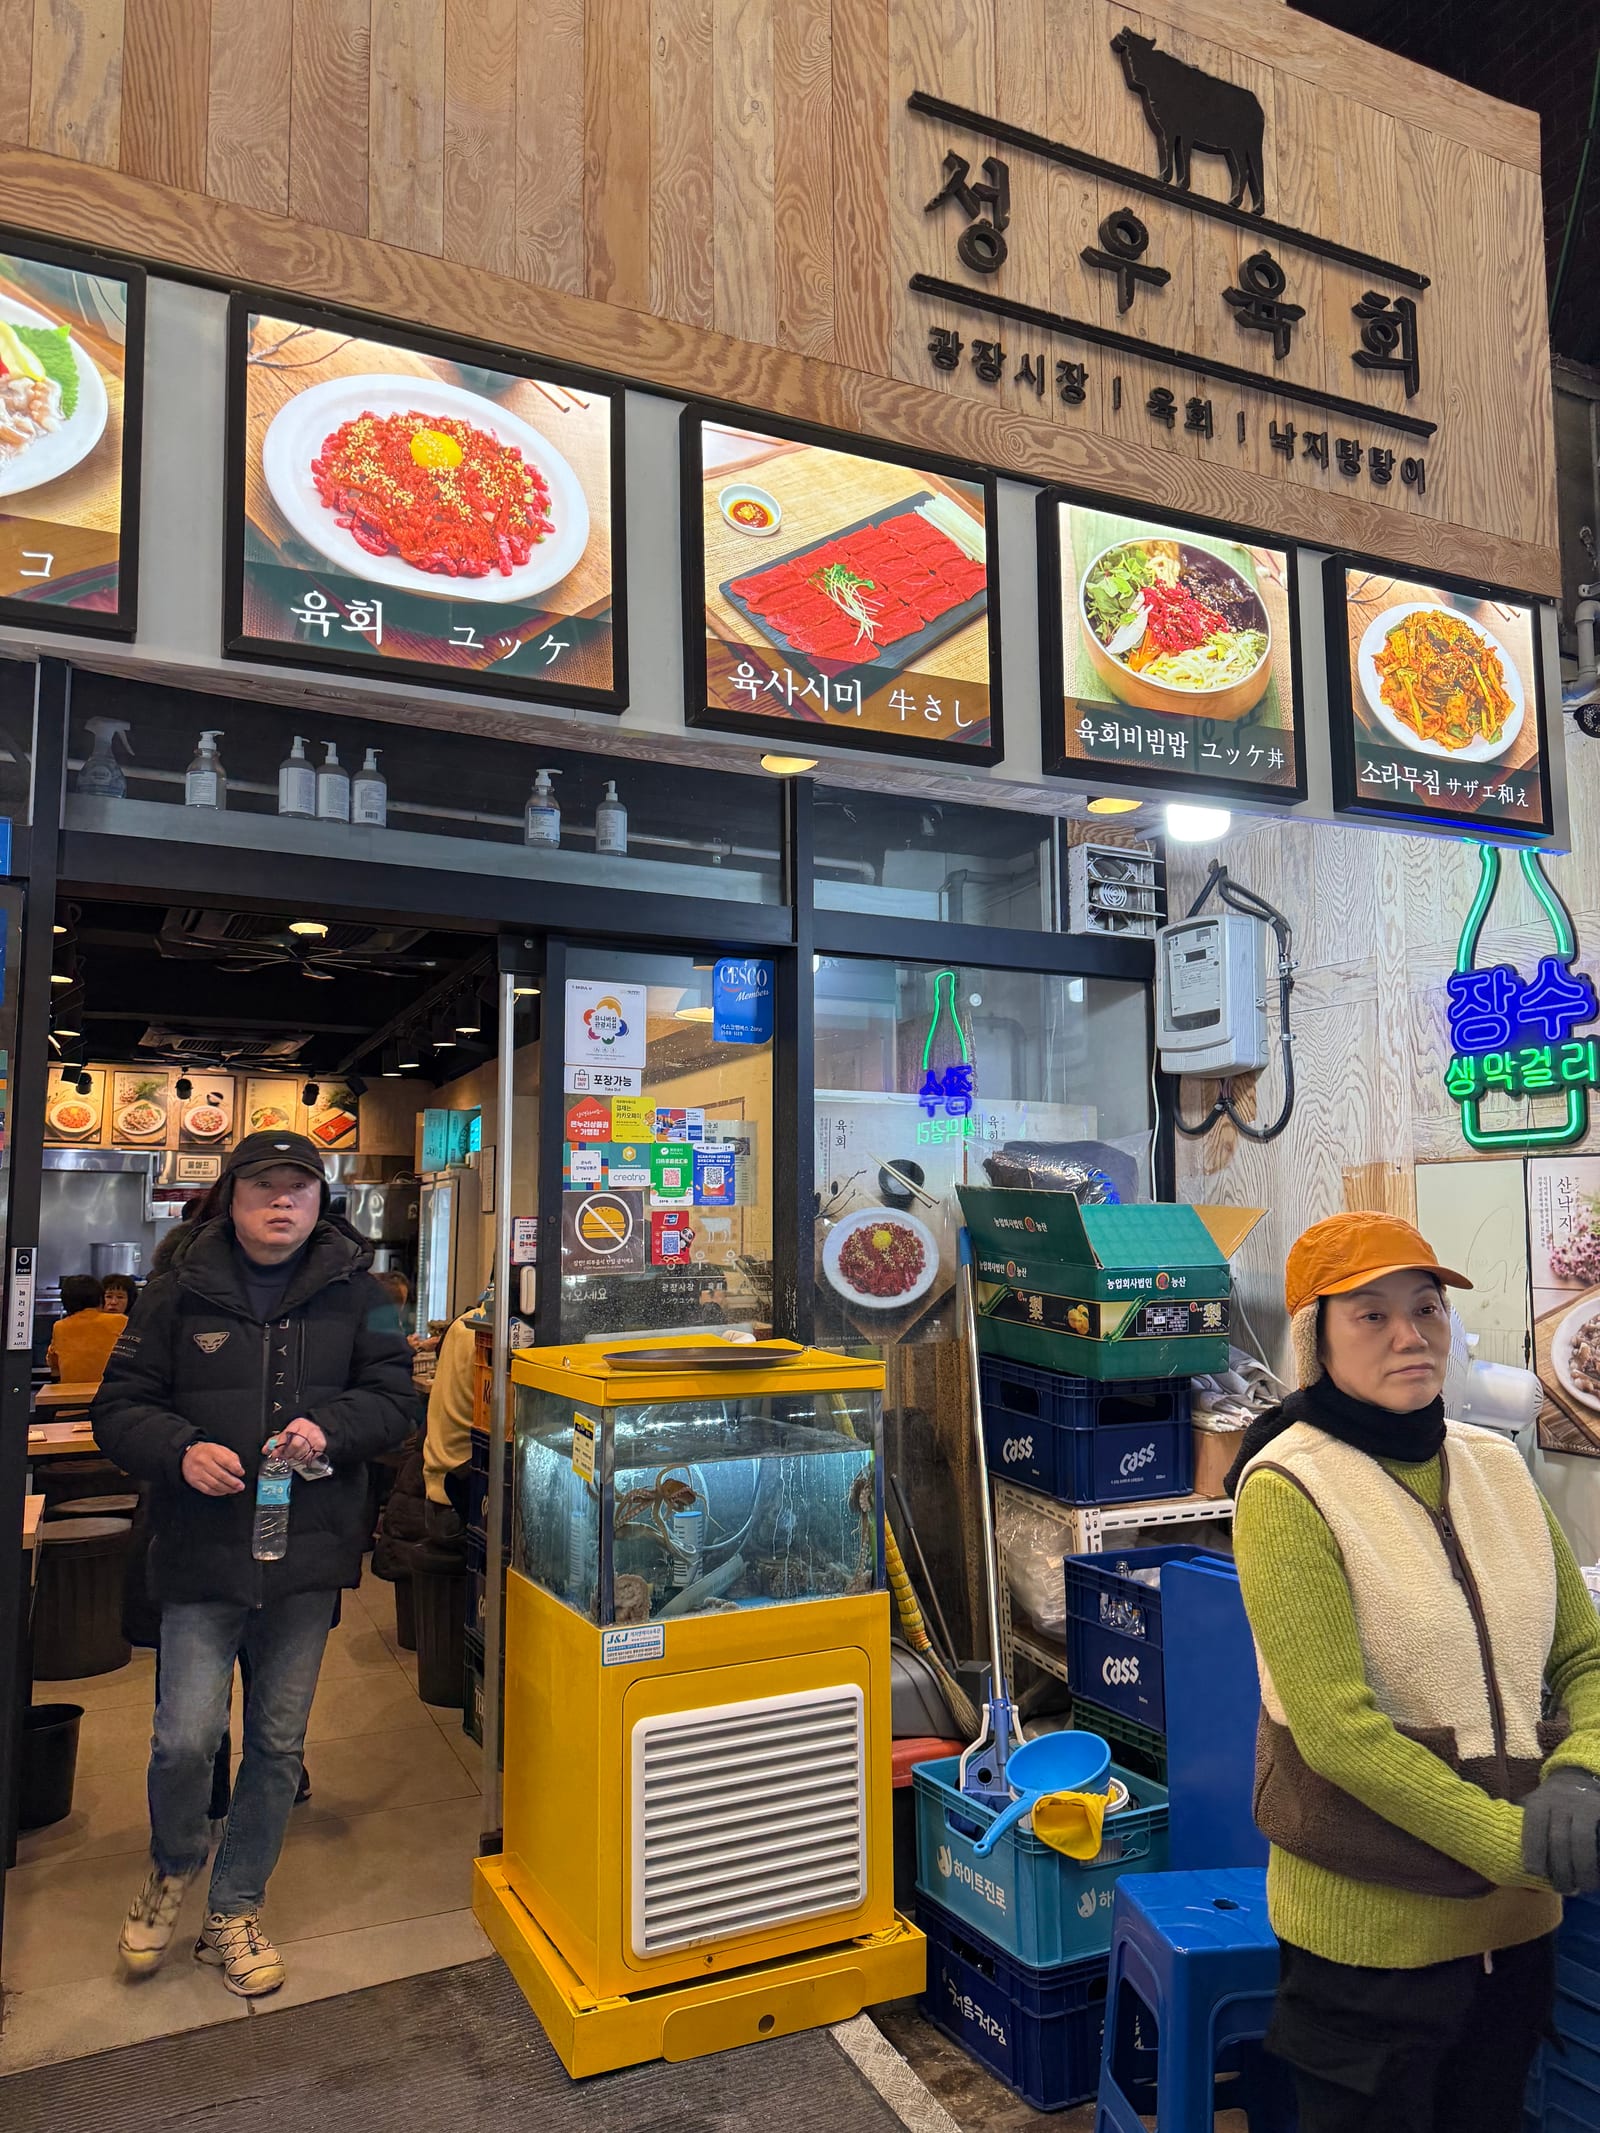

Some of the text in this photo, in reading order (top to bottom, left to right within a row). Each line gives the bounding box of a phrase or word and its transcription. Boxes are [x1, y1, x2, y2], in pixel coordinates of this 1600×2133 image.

[923, 149, 1420, 399] 성우육회
[928, 326, 1427, 494] 광장시장 육회 낙지탕탕이
[290, 590, 571, 665] 육회 ユッケ
[727, 661, 974, 728] 육사시미 牛さし
[1074, 720, 1285, 769] 육회비빔밥 ユッケ丼
[1360, 761, 1530, 808] 소라무침 サザエ和え
[720, 965, 768, 987] CESCO
[736, 987, 770, 1002] Members
[1448, 959, 1591, 1051] 장수
[593, 1074, 632, 1087] 포장가능
[1446, 1039, 1600, 1096] 생막걸리
[835, 1119, 847, 1149] 육회
[613, 1173, 646, 1183] creatrip
[993, 1217, 1049, 1233] 농업회사법인 농산
[1557, 1175, 1573, 1233] 산낙지
[978, 1260, 1028, 1279] 농업회사법인 농산
[1106, 1276, 1187, 1291] 농업회사법인 농산
[607, 1632, 629, 1645] J&J
[953, 1858, 1007, 1912] 하이트진로
[948, 1978, 1008, 2047] 처음처럼
